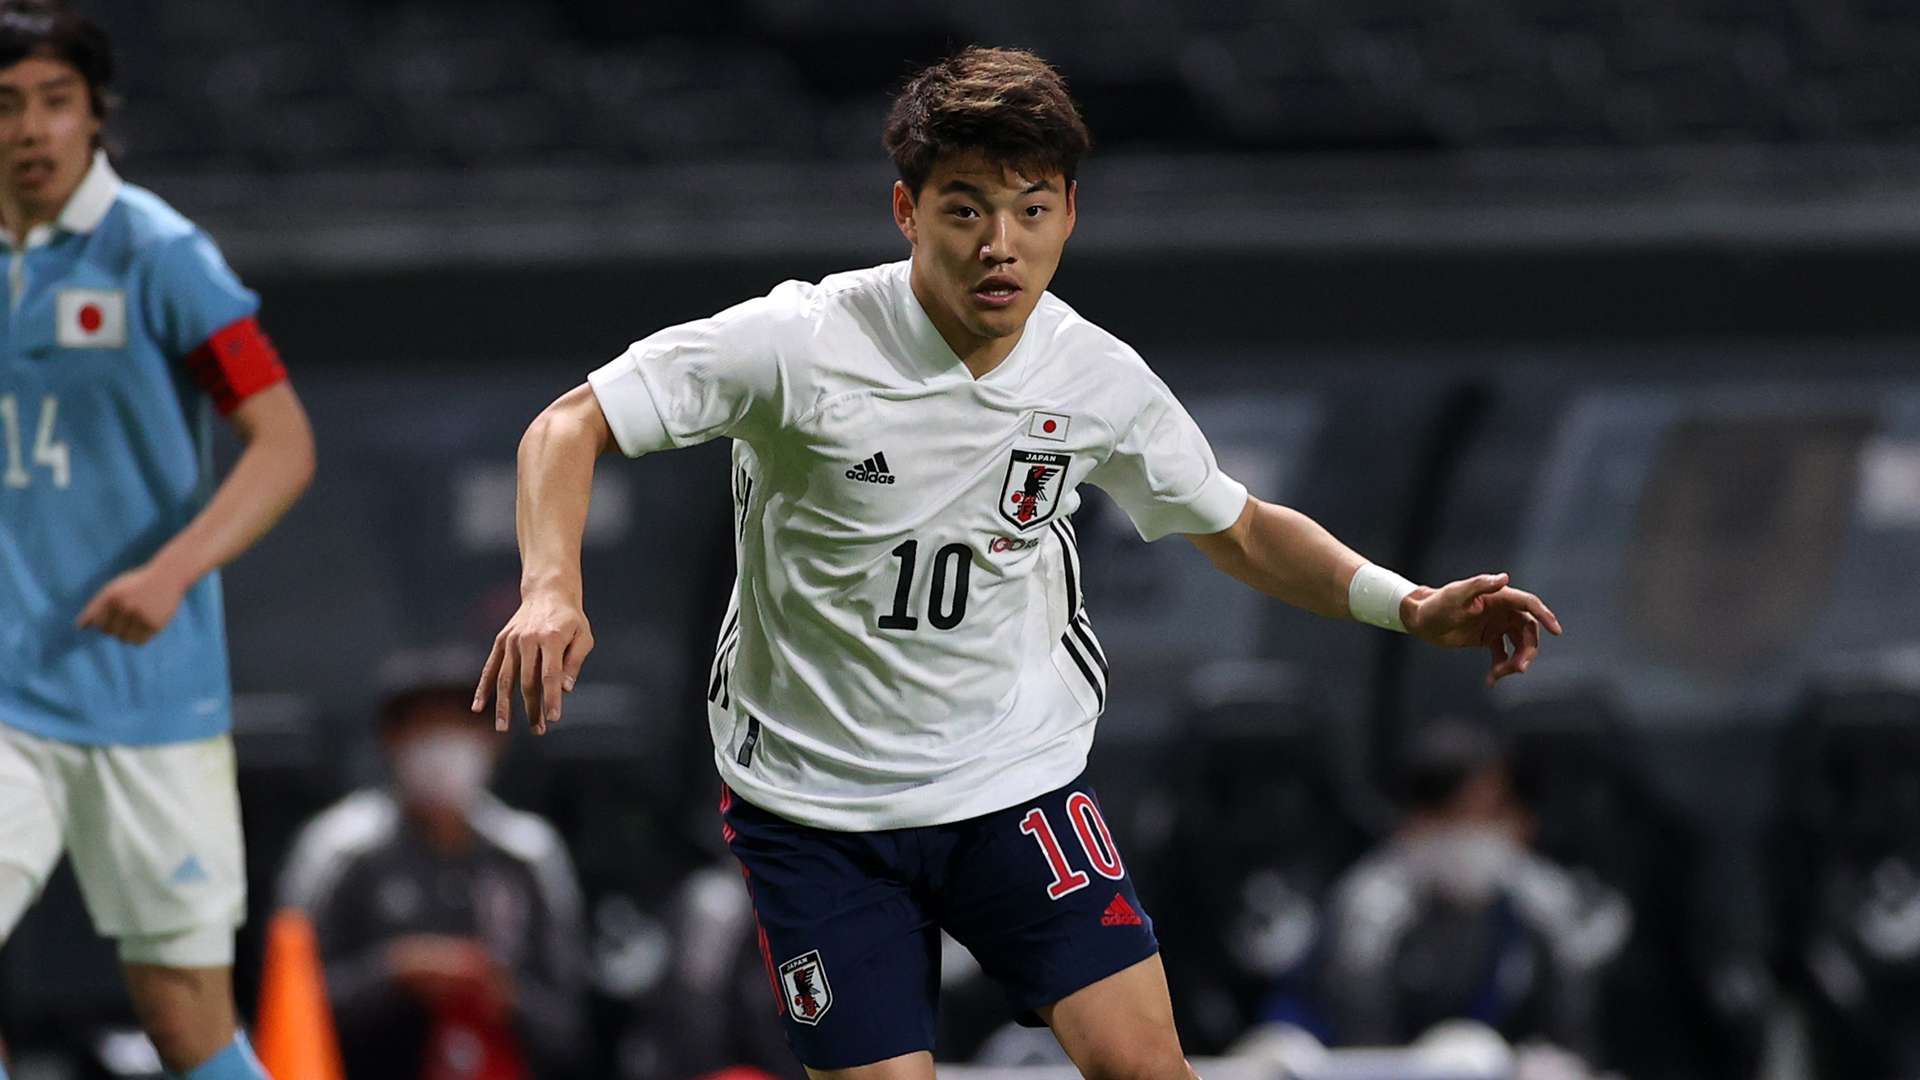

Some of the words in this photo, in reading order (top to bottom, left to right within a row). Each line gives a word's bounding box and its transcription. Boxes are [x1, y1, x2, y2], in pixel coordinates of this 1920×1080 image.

[0, 395, 71, 489] 14
[1025, 453, 1057, 462] JAPAN
[845, 470, 895, 484] adidas
[878, 539, 972, 630] 10
[1019, 792, 1124, 900] 10
[1100, 912, 1141, 926] adidas
[786, 956, 809, 972] JAPAN
